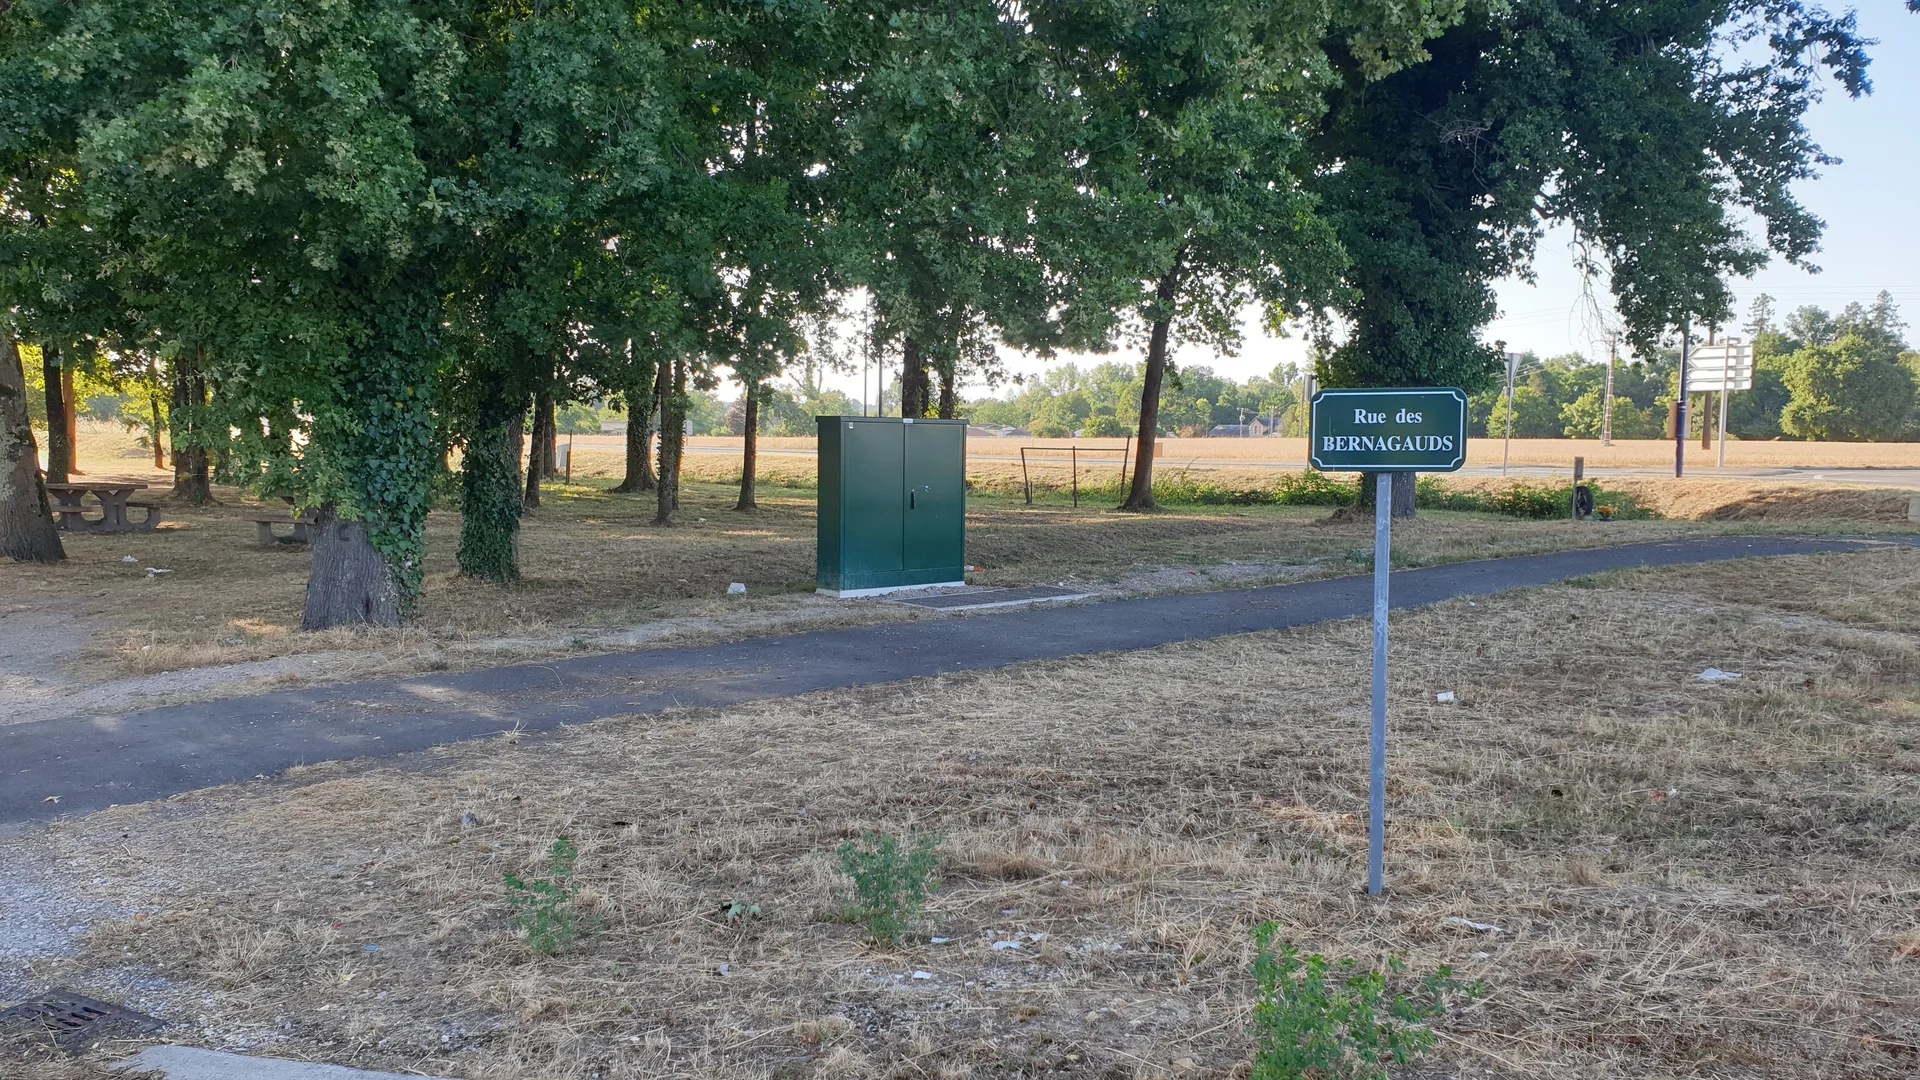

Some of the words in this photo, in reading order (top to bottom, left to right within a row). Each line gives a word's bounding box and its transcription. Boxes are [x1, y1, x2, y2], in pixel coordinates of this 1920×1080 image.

[1354, 408, 1386, 424] Rue
[1395, 407, 1423, 424] des
[1322, 435, 1453, 451] BERNAGAUDS
